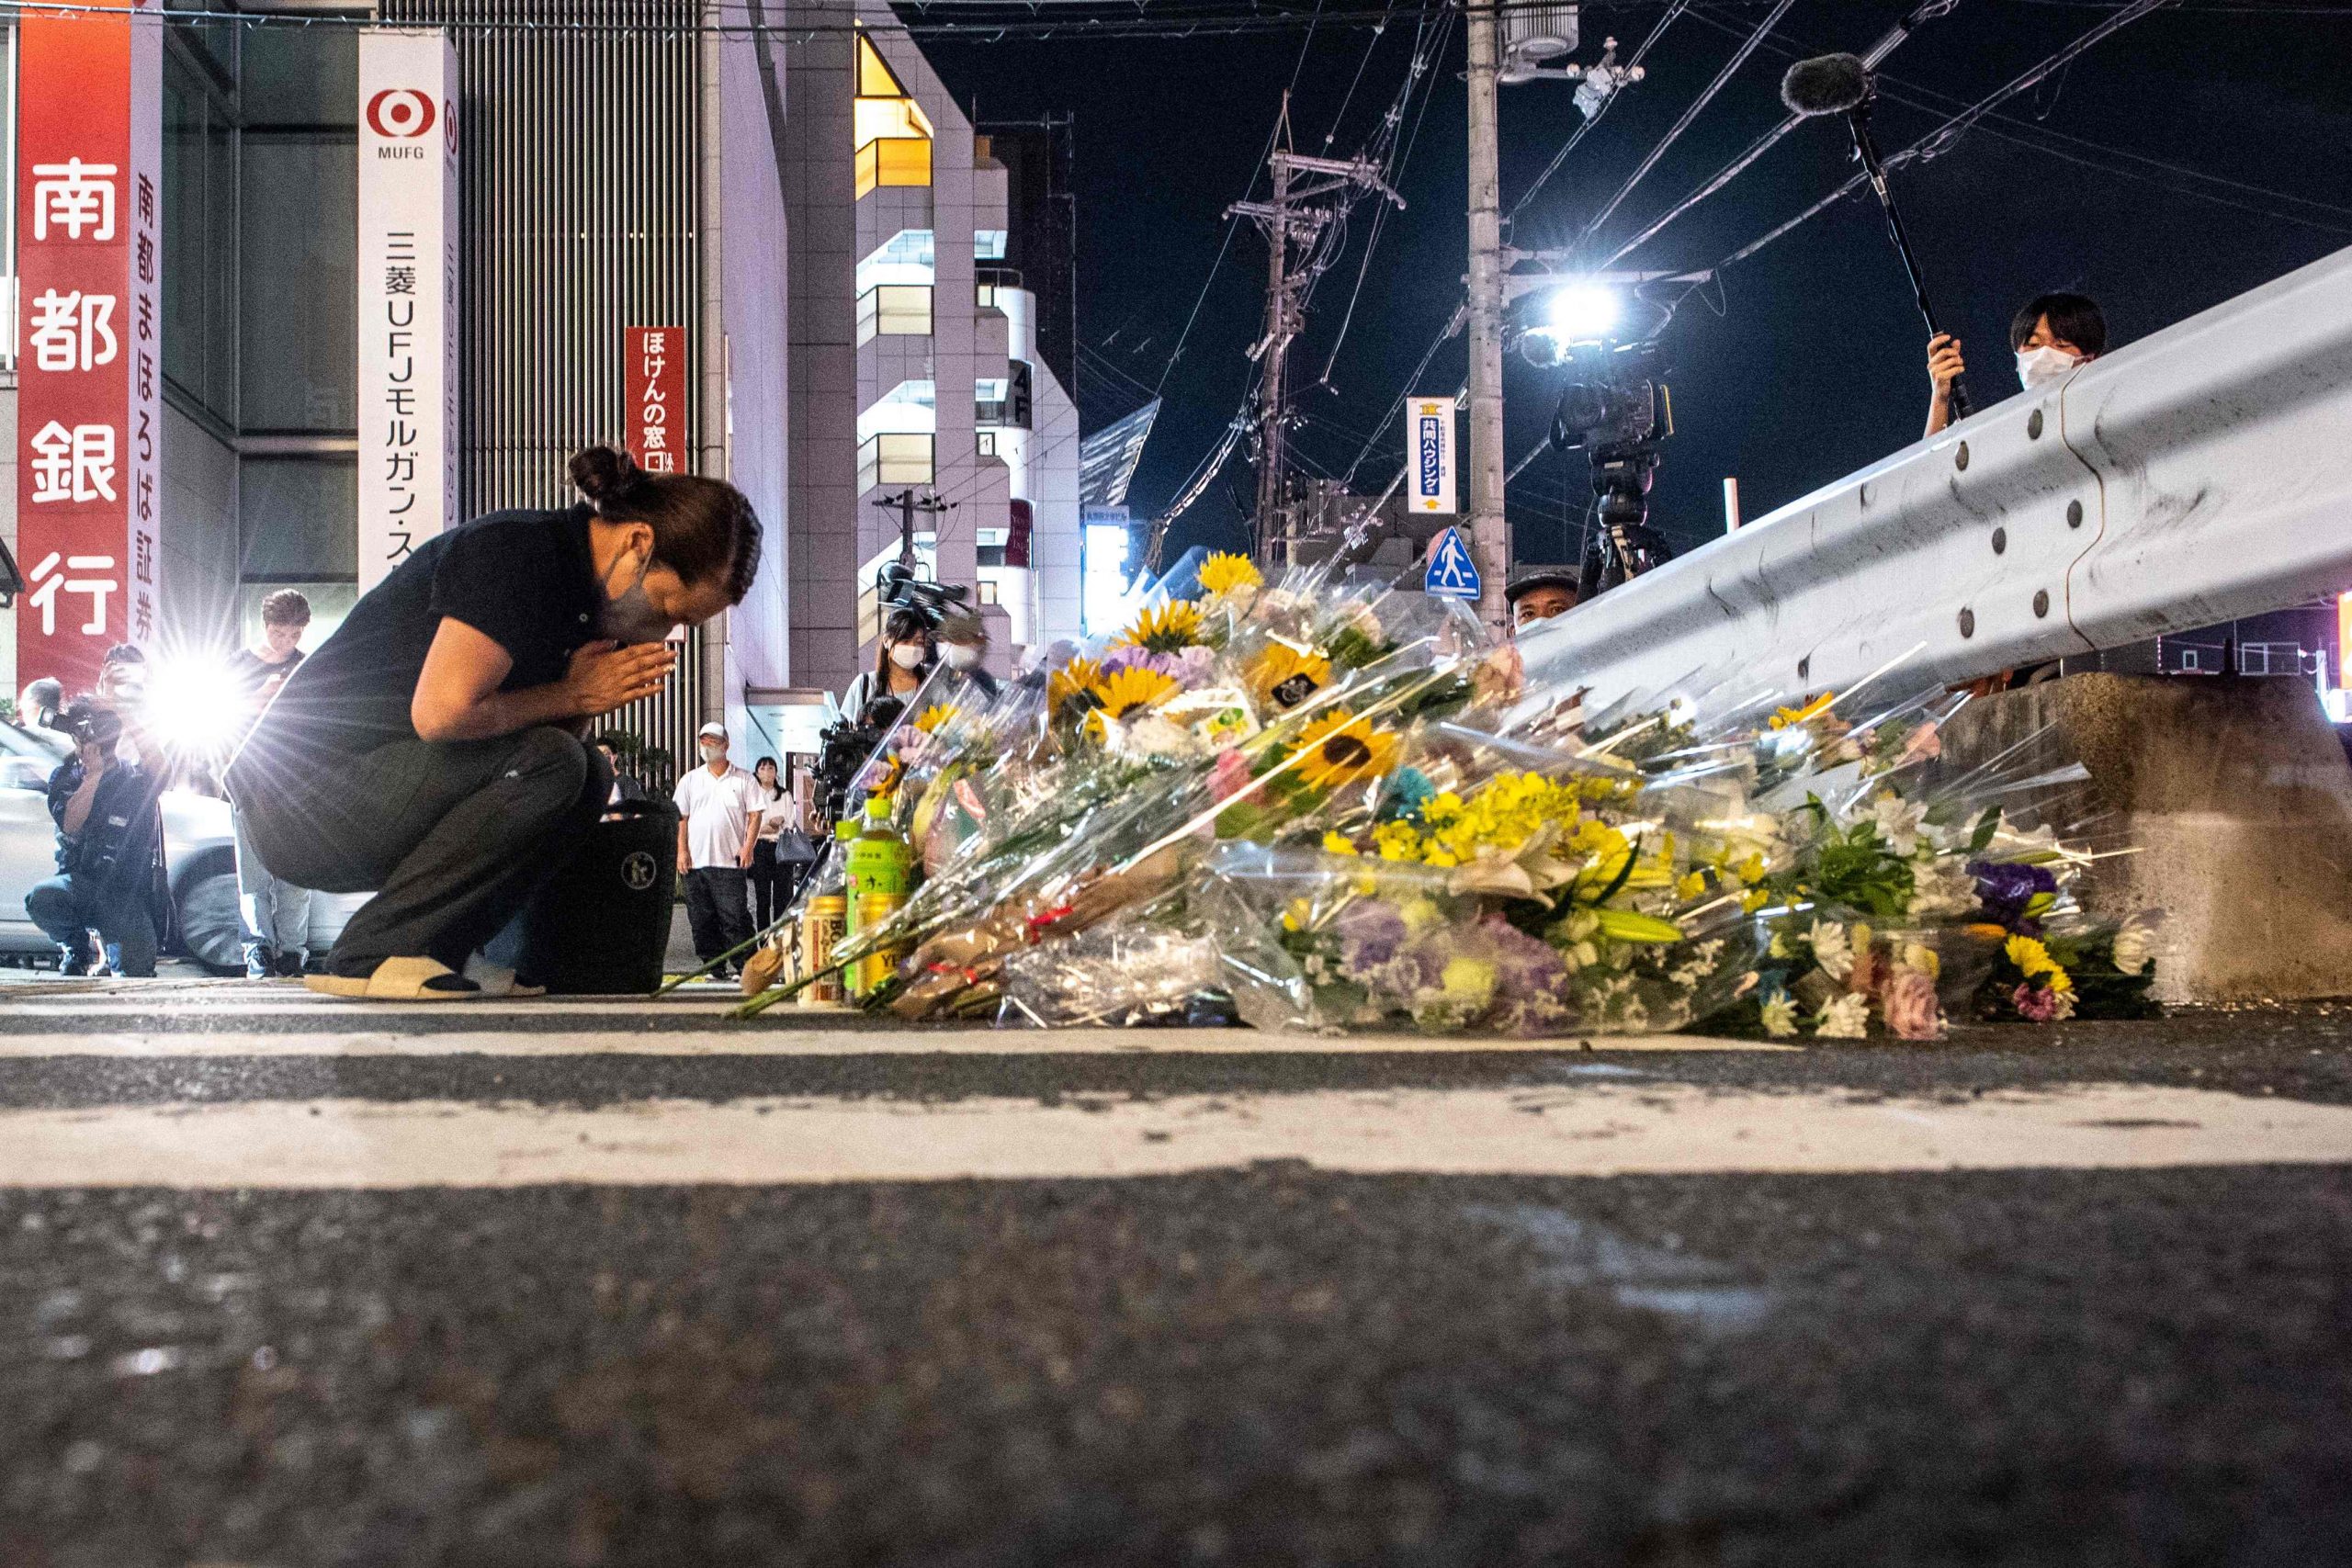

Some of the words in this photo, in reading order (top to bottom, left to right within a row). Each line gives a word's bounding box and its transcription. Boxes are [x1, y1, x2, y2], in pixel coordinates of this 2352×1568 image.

[378, 146, 424, 160] MUFG
[29, 156, 118, 637] 南都銀行
[136, 171, 154, 641] 南都まほろば証券
[385, 231, 419, 571] 三菱UFJモルガン・ス
[643, 332, 666, 472] ほけんの窓口
[1013, 367, 1029, 423] 4F
